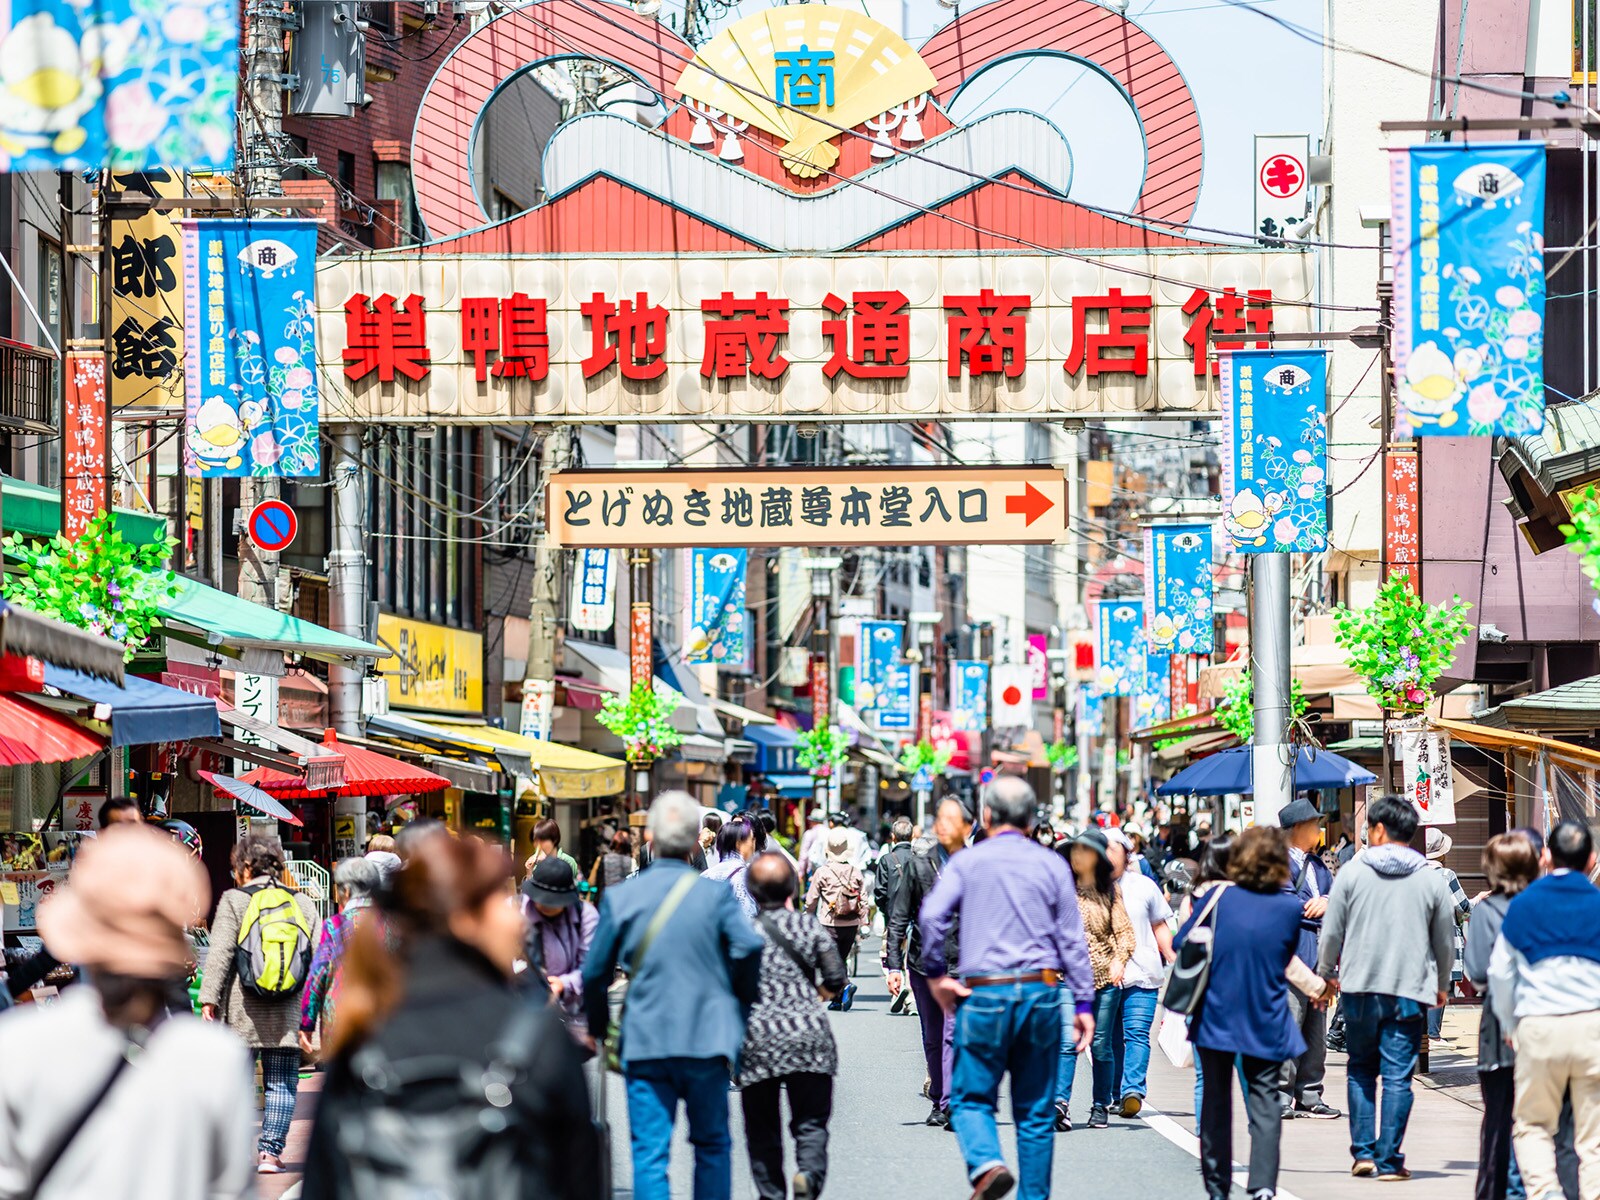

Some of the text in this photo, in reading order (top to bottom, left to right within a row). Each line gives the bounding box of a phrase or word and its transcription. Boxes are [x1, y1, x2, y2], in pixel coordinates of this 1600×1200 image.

[321, 68, 340, 83] 75
[774, 44, 835, 108] 商
[257, 246, 276, 266] 商
[342, 288, 1274, 383] 巣鴨地蔵通商店街
[1279, 369, 1295, 386] 商
[1239, 365, 1254, 481] 巣鴨地蔵通り商店街
[564, 486, 988, 528] とげぬき地蔵尊本堂入口
[1417, 738, 1429, 763] 名物
[75, 801, 94, 831] 慶祝
